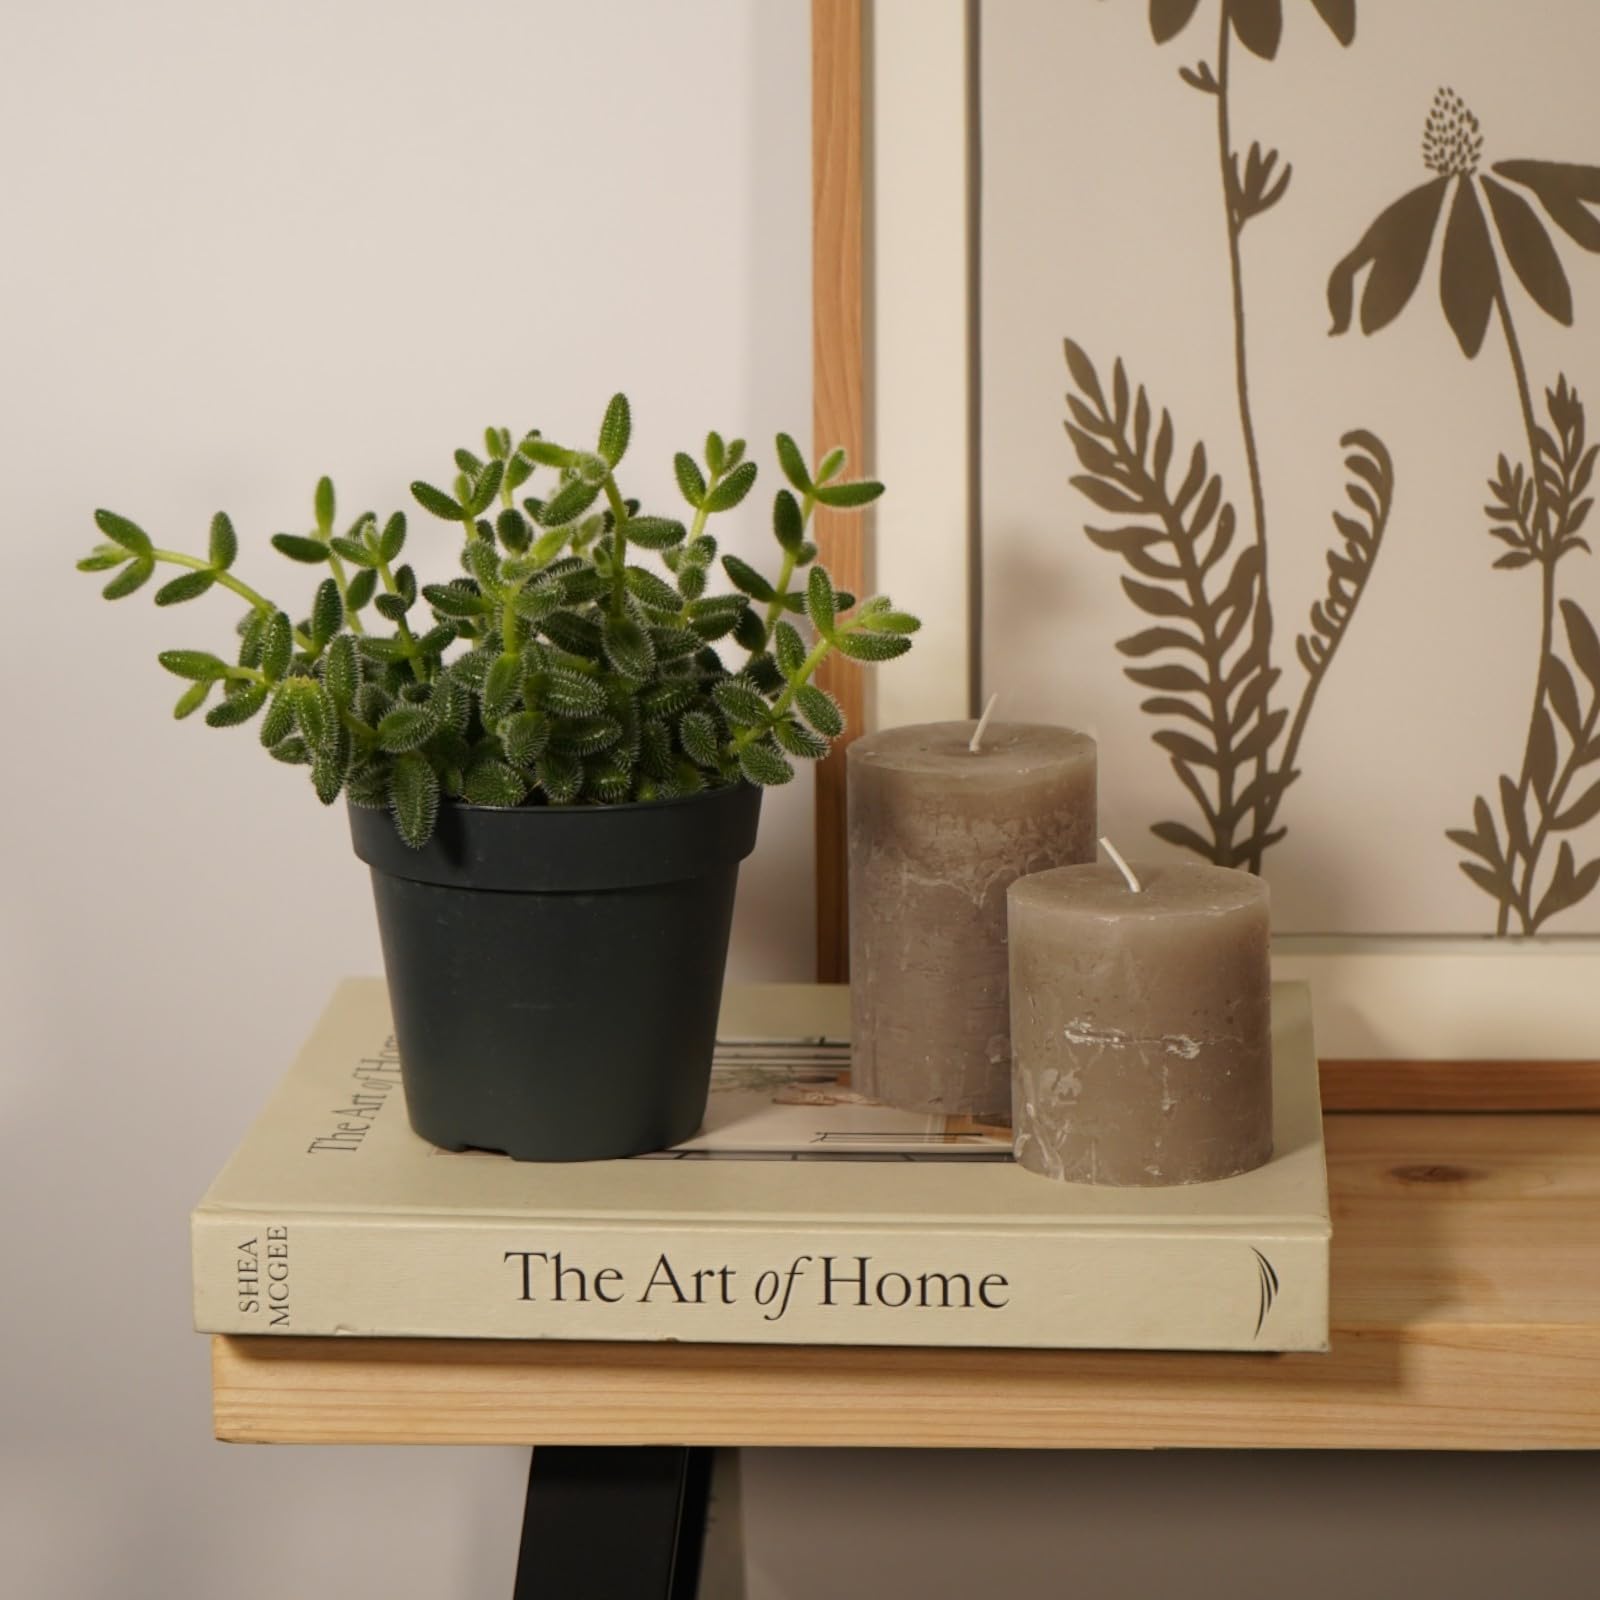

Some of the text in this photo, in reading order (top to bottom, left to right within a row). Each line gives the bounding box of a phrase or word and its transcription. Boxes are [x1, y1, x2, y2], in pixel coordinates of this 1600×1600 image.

[352, 1071, 402, 1091] of
[331, 1093, 388, 1121] Art
[307, 1121, 371, 1154] The
[237, 1237, 258, 1313] SHEA
[267, 1225, 290, 1327] MCGEE
[504, 1251, 1009, 1320] The Art of Home
